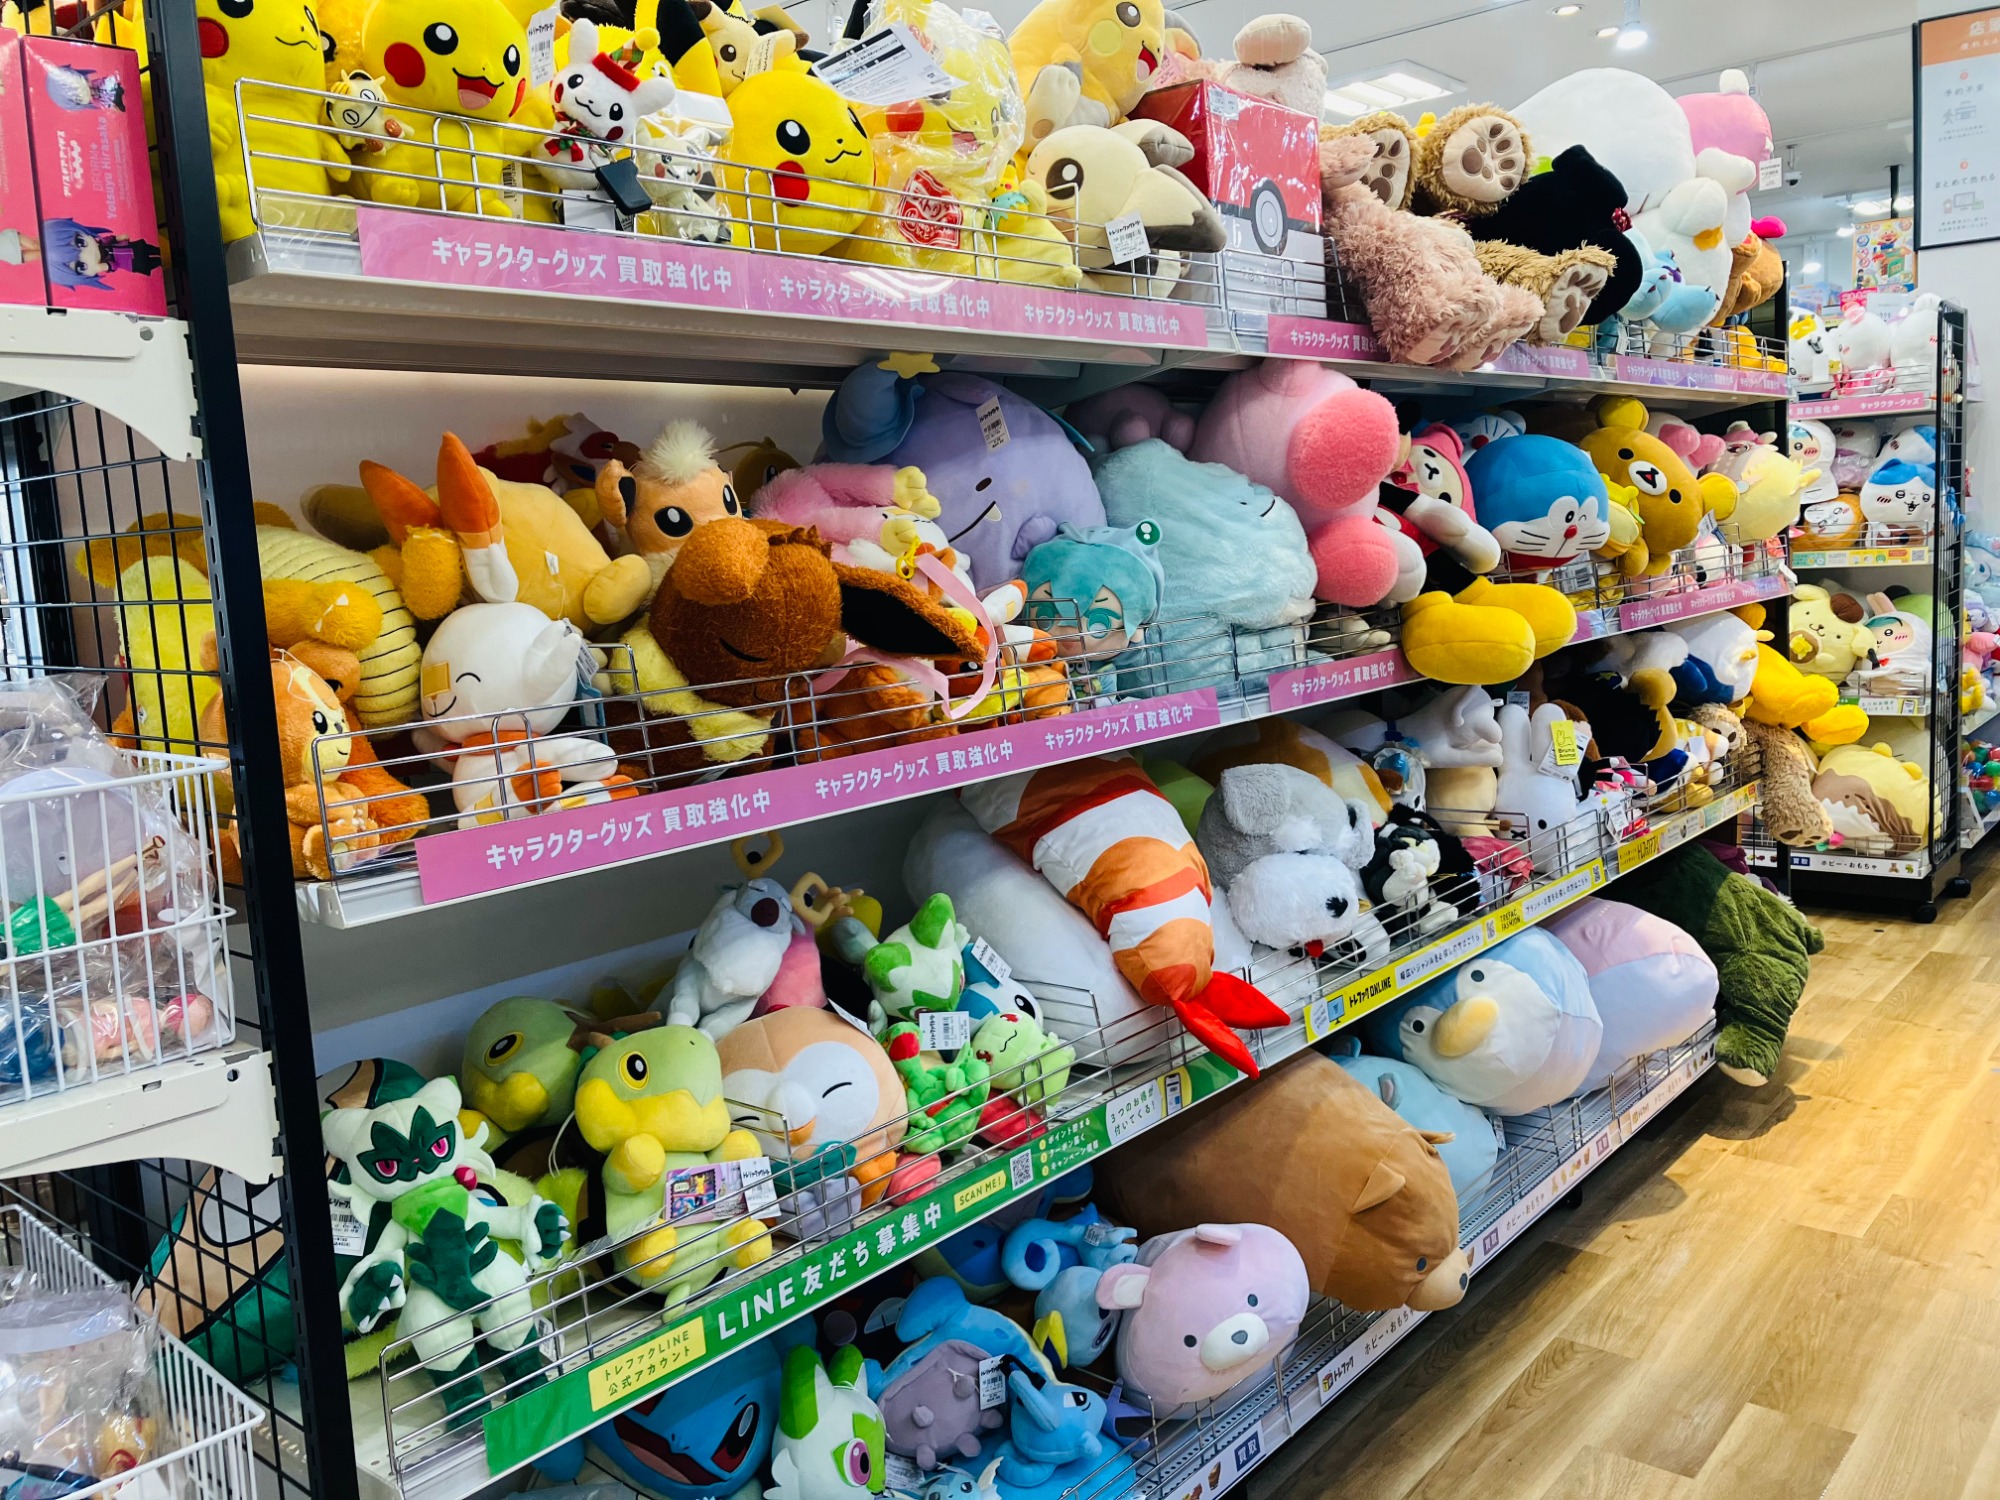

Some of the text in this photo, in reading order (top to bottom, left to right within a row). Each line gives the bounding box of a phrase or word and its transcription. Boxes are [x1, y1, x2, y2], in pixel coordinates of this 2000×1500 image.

[97, 116, 112, 170] Hirasaka
[432, 236, 732, 293] キャラクターグッズ 買取強化中
[780, 276, 990, 319] キャラクターグッズ 買取強化中
[1024, 303, 1181, 336] キャラクターグッズ 買取強化中
[1290, 329, 1350, 349] キャラクターグッズ
[1291, 660, 1395, 696] キャラクターグッズ 買取強化中
[1045, 703, 1193, 751] キャラクターグッズ 買取強化中
[815, 739, 1014, 800] キャラクターグッズ 買取強化中
[486, 788, 771, 870] キャラクターグッズ 買取強化中
[1821, 860, 1877, 870] ホビー・おもちゃ
[1500, 908, 1517, 922] TREFAC
[1501, 917, 1520, 931] FASHION
[959, 1173, 1001, 1206] SCAN ME!
[604, 1330, 689, 1381] トレファクLINE
[608, 1345, 690, 1396] 公式アカウント
[1333, 1356, 1354, 1382] トレファク
[1237, 1438, 1257, 1464] 買取
